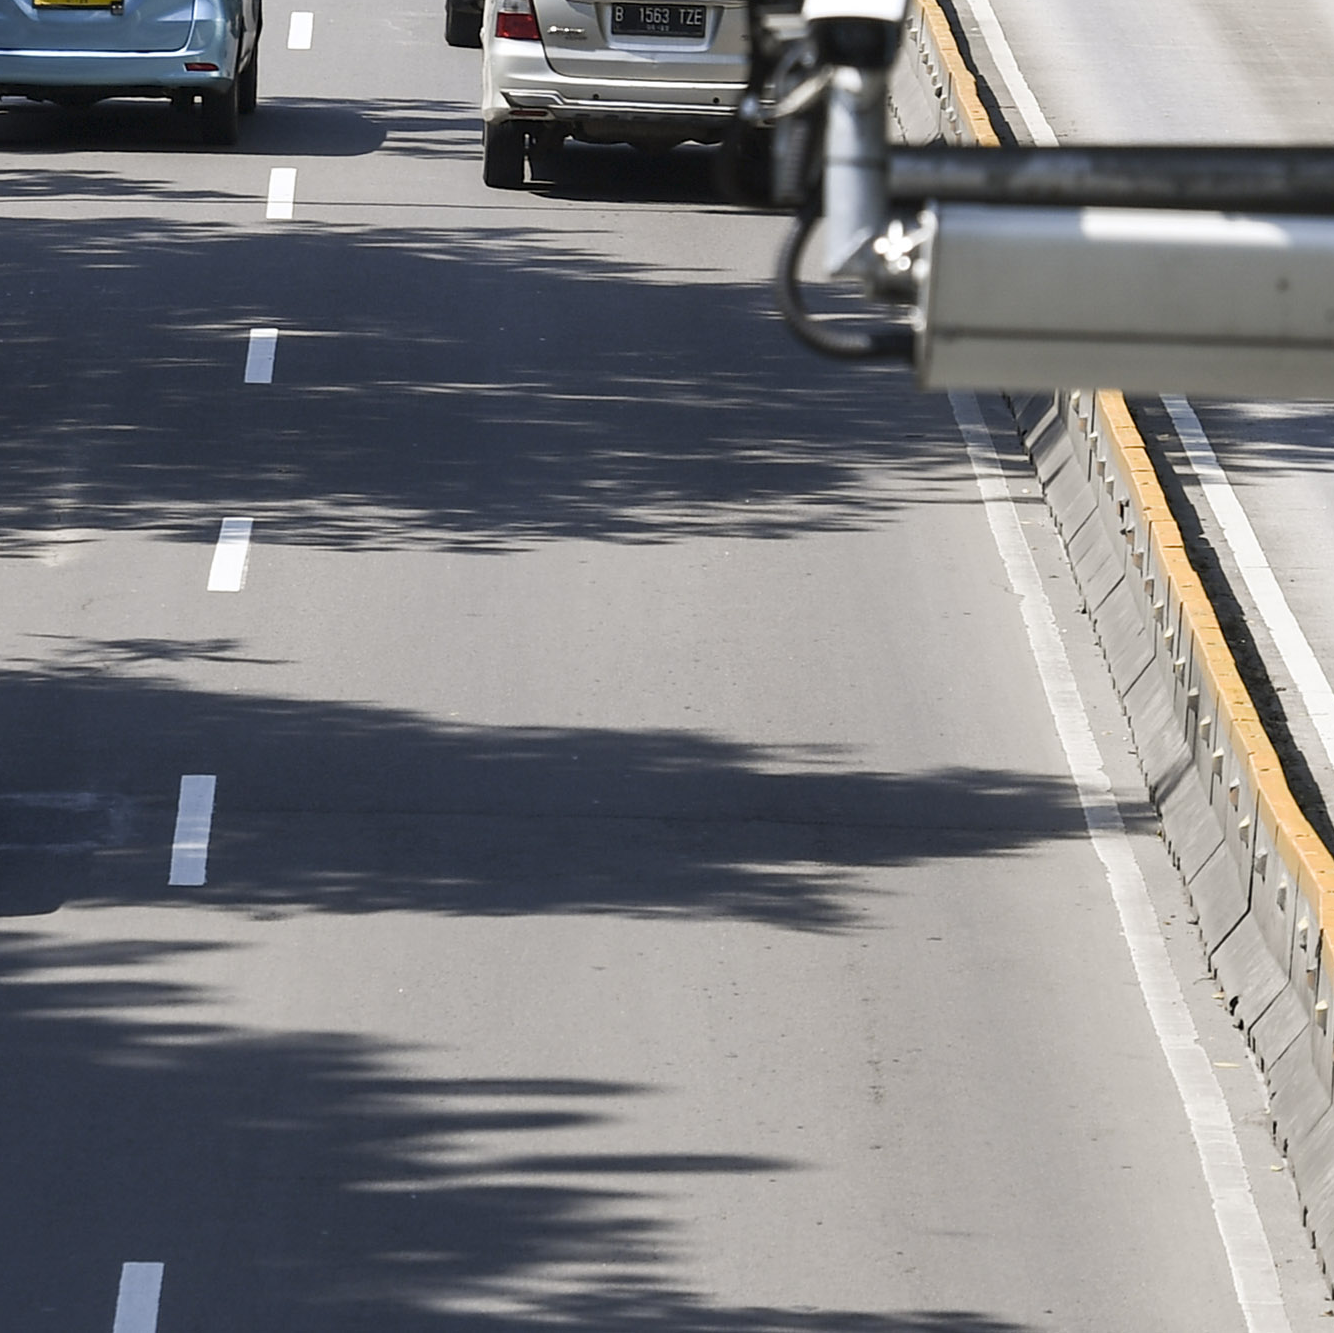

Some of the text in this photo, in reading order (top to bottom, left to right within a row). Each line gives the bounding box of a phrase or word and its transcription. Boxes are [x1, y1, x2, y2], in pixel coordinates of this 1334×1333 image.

[615, 6, 703, 25] B 1563 TZE
